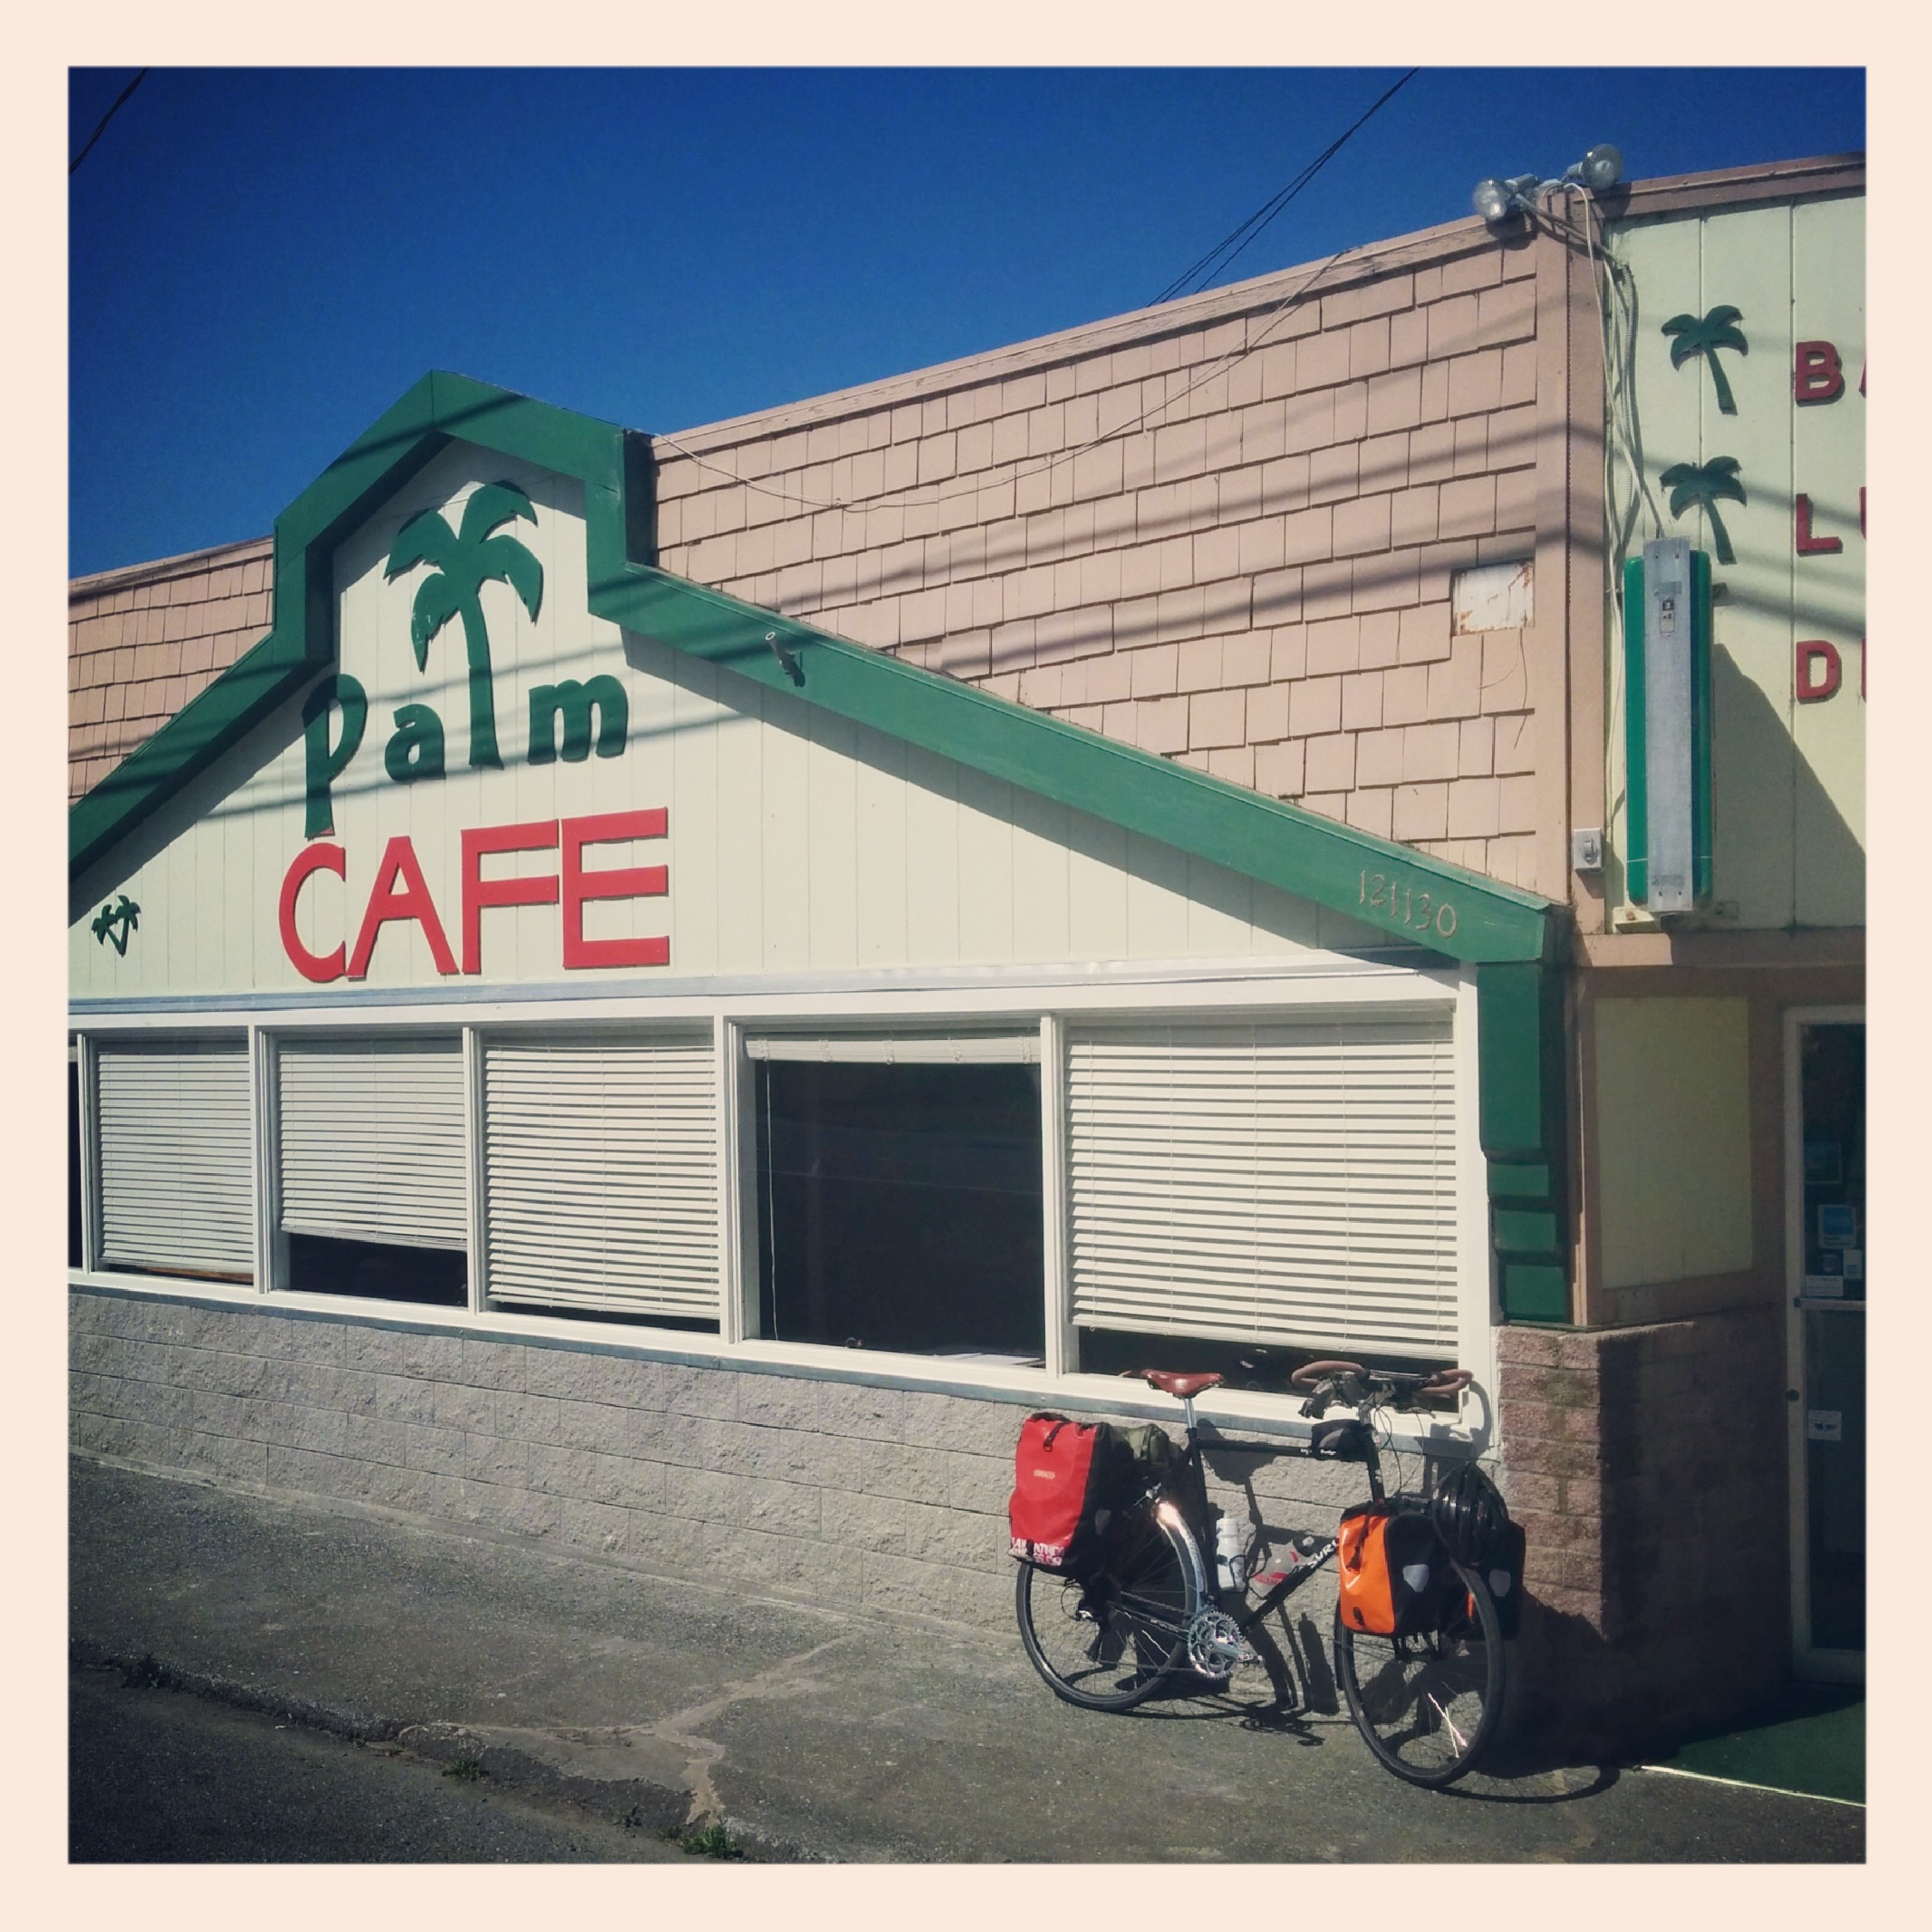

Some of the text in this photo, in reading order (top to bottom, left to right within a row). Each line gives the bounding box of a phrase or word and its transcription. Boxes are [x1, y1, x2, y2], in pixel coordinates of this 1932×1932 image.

[1794, 339, 1866, 406] B
[1794, 486, 1866, 557] L
[1794, 639, 1866, 705] D
[302, 602, 629, 841] Palm
[278, 806, 669, 983] CAFE
